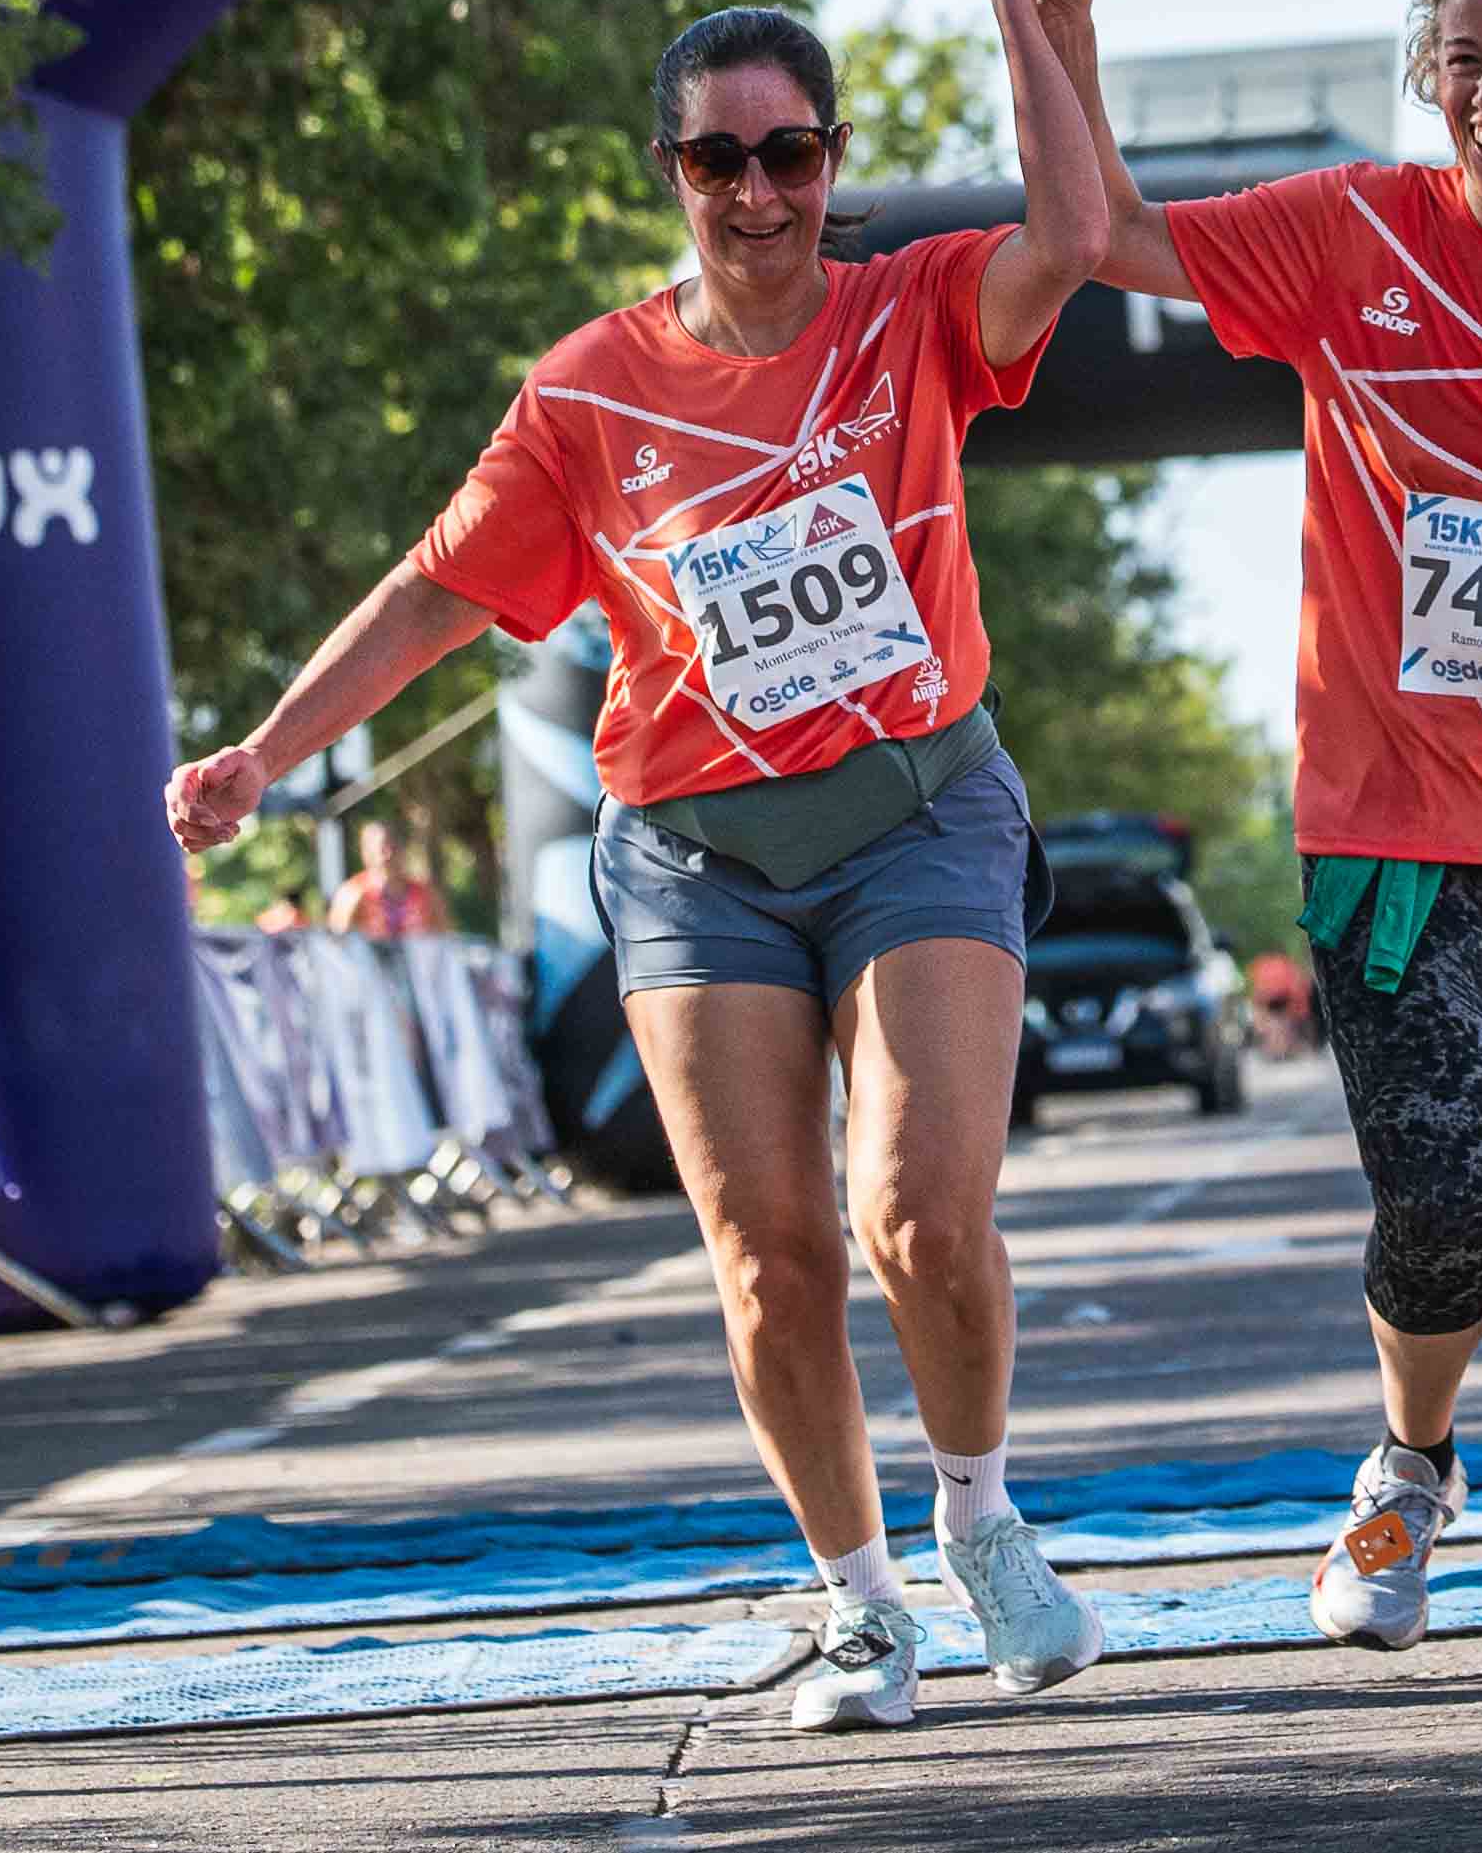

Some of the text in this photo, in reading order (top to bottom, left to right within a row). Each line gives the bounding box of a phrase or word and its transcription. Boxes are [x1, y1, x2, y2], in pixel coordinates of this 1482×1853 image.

[788, 428, 848, 483] 15K
[810, 514, 843, 539] 15K
[690, 542, 749, 587] 15K
[698, 542, 889, 666] 1509
[753, 636, 828, 673] Montenegro
[830, 620, 866, 645] Ivana
[749, 674, 816, 713] osde
